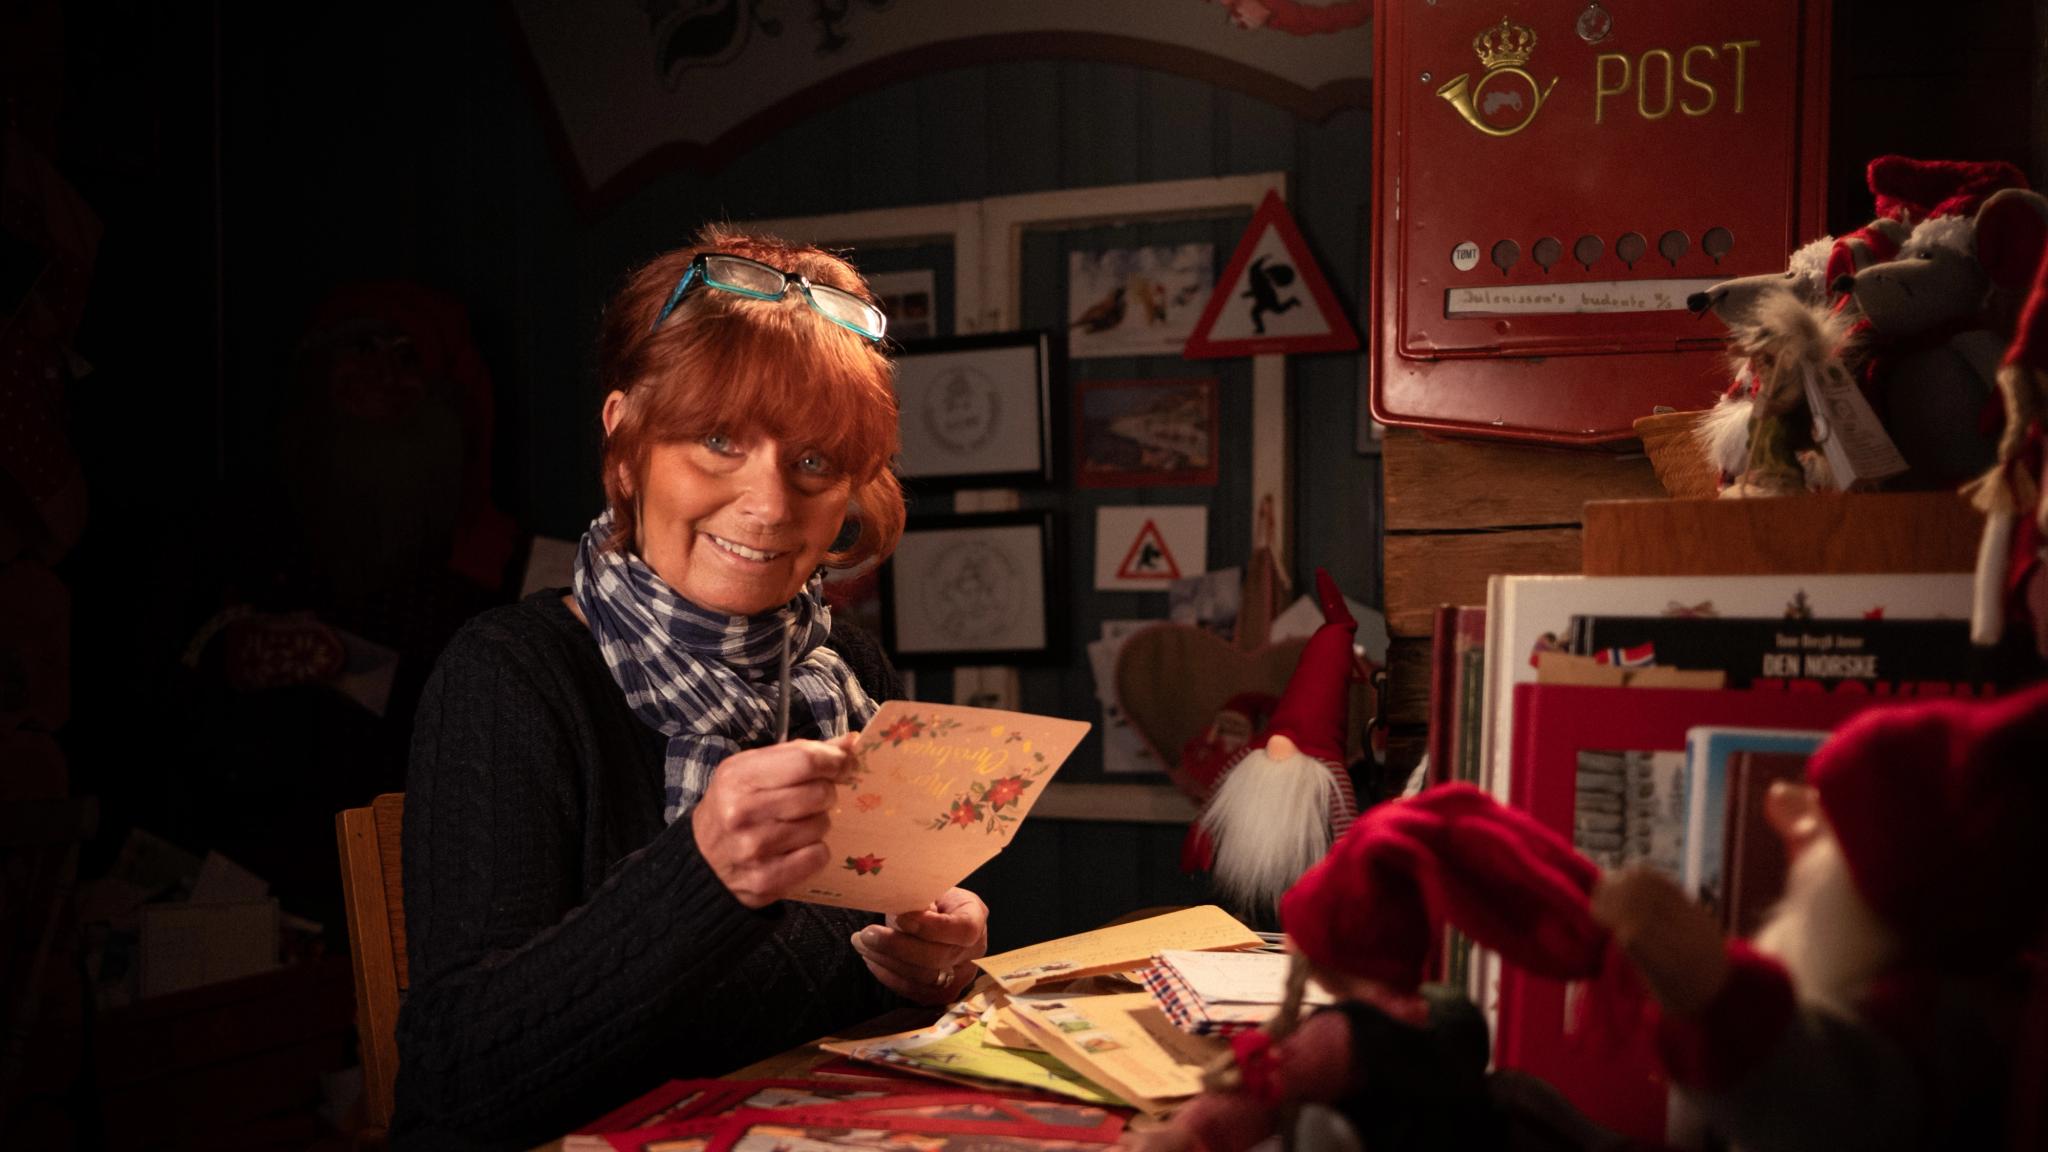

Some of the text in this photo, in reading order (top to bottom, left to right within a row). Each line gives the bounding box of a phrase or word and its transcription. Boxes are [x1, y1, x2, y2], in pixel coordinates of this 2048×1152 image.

[1595, 40, 1760, 124] POST
[1763, 653, 1879, 678] DEN NORSKE
